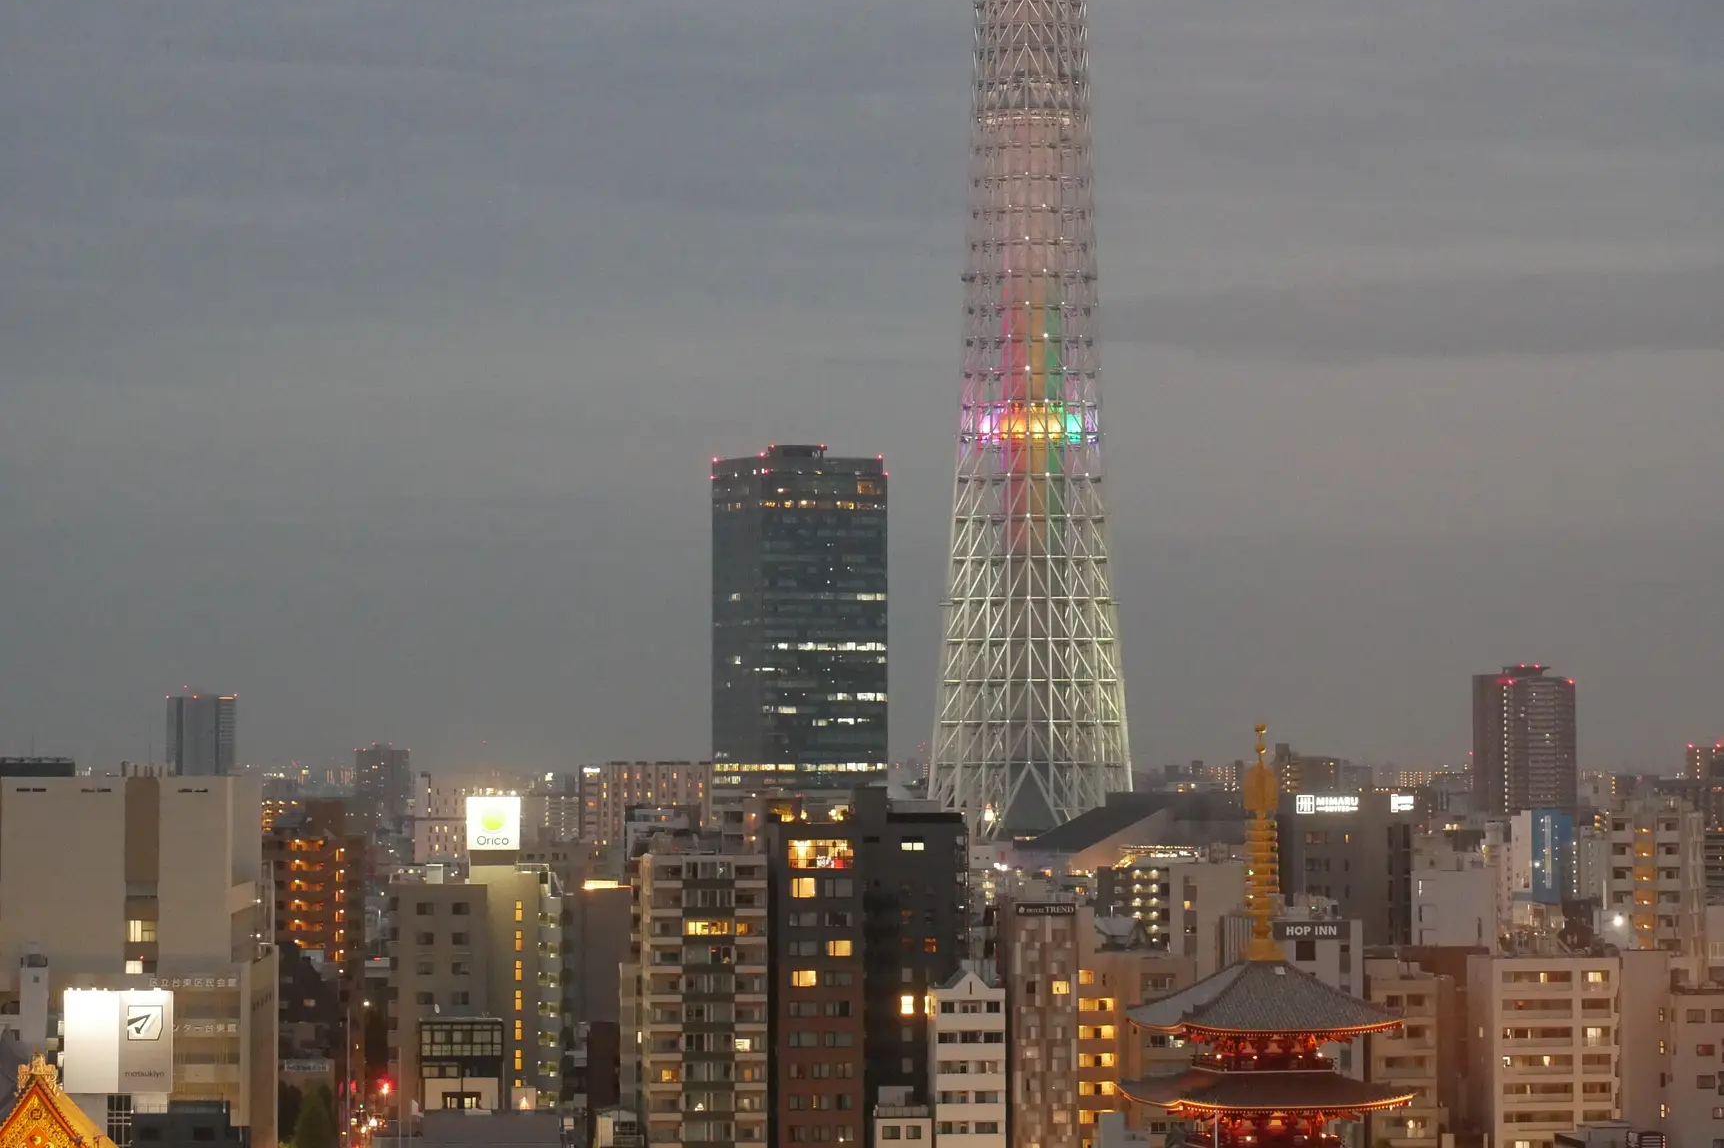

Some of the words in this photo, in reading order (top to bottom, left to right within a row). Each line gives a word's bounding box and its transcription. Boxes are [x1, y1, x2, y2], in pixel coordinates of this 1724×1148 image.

[1316, 796, 1359, 806] MIMARU
[477, 835, 509, 846] Orico
[1045, 905, 1074, 913] TREND
[1286, 925, 1311, 936] HOP
[1314, 925, 1337, 936] INN
[124, 1070, 165, 1080] matsukiyo
